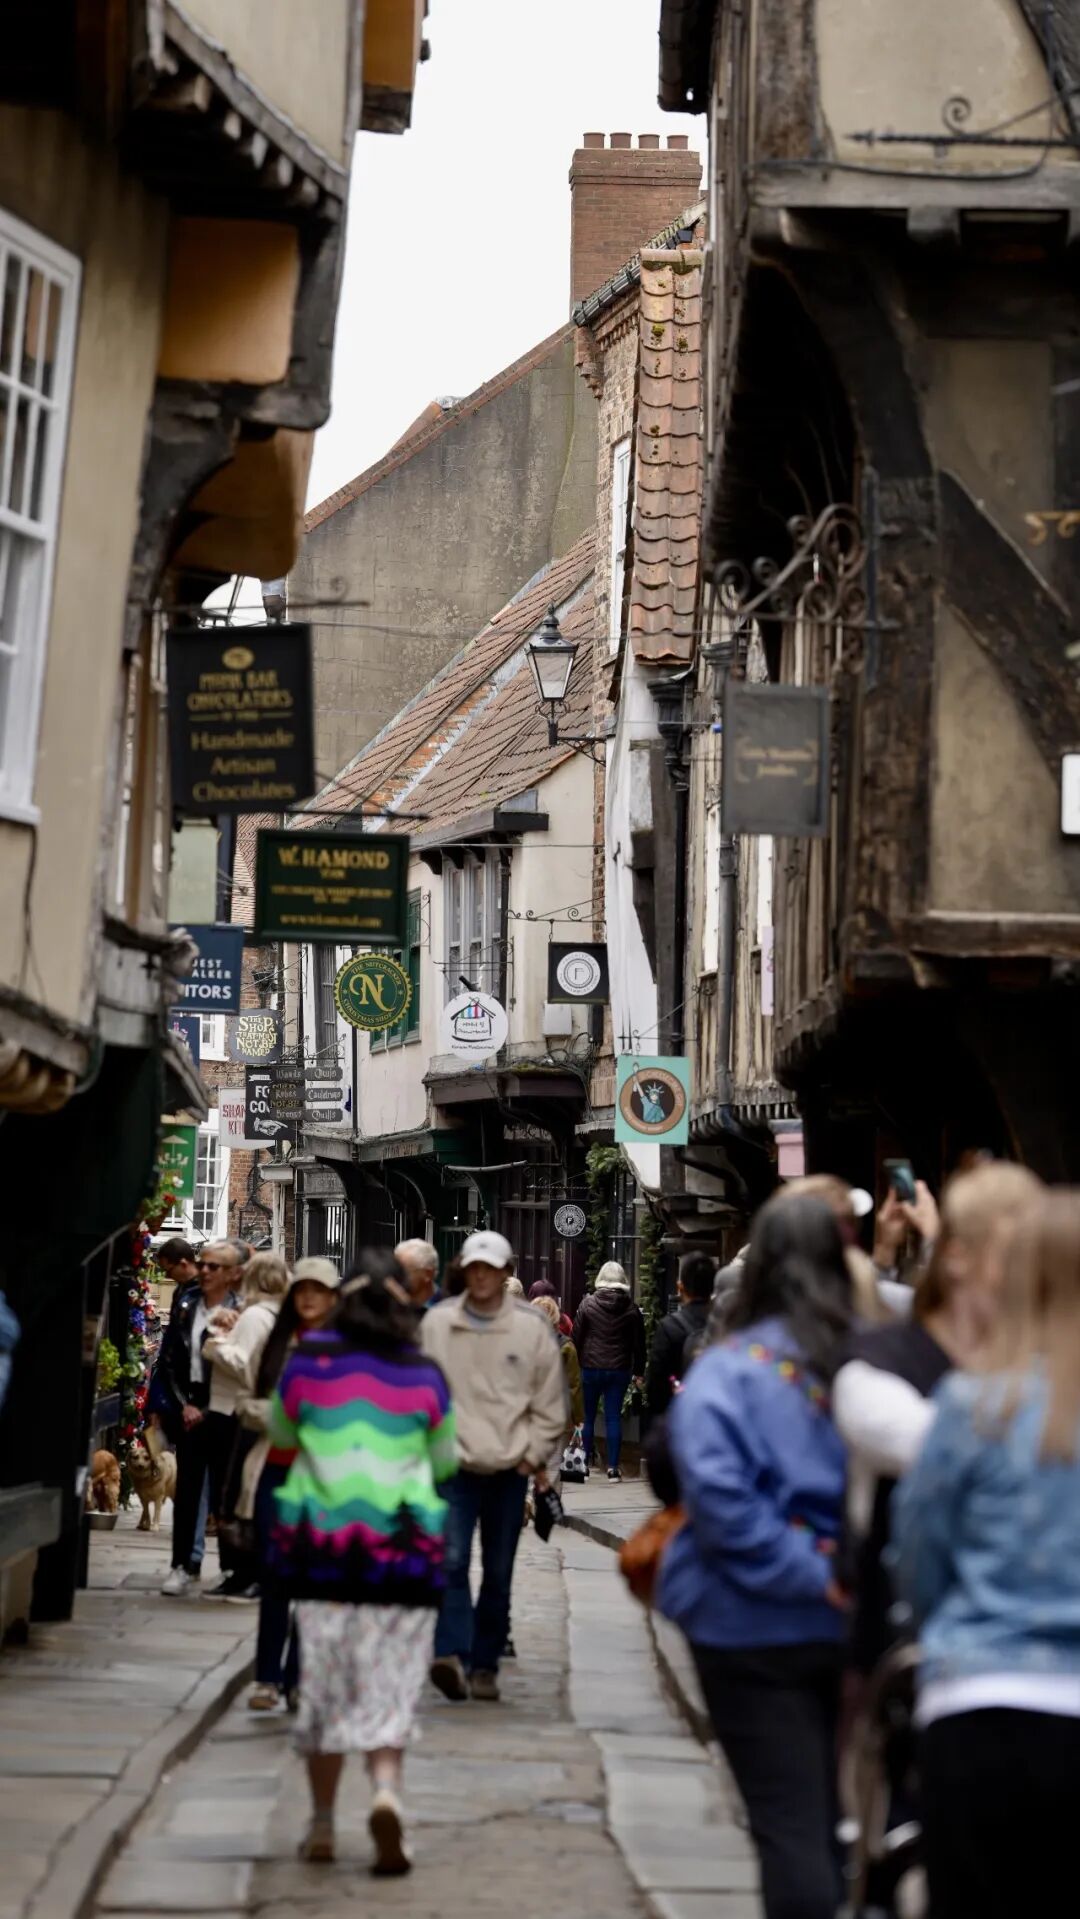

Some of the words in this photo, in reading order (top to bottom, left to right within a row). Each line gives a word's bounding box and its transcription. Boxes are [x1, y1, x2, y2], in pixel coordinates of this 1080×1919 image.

[191, 728, 294, 751] Handmade
[210, 757, 277, 775] Artisan
[192, 780, 295, 801] Chocolates
[302, 848, 390, 869] HAMOND
[191, 969, 232, 980] ALKER
[184, 983, 232, 1000] ITORS
[349, 973, 396, 1012] N
[238, 1016, 274, 1033] SHOP
[236, 1037, 259, 1050] NOT
